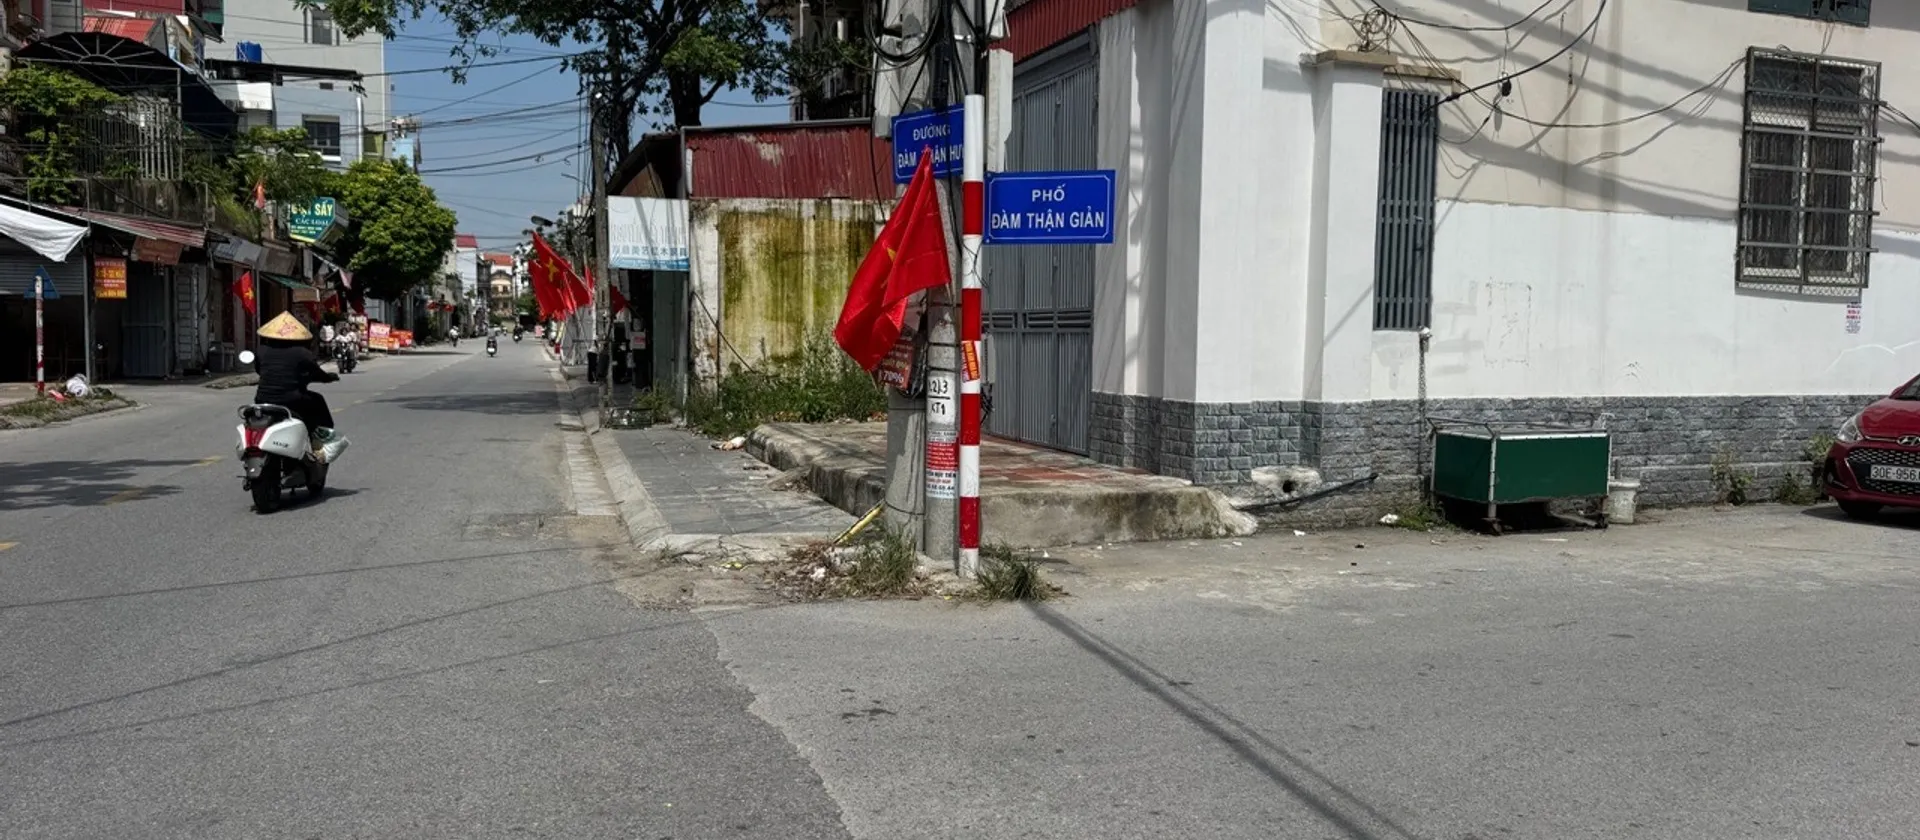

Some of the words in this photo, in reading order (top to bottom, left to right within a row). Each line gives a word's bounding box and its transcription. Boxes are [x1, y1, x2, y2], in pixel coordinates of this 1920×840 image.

[913, 123, 951, 141] ĐƯỜNG
[898, 148, 917, 169] ĐÀM
[921, 144, 947, 167] ẬN
[1031, 183, 1066, 202] PHỐ
[991, 208, 1021, 229] ĐÀM
[1026, 208, 1065, 232] THẬN
[1069, 205, 1105, 228] GIẢN
[1871, 465, 1920, 482] 30E-956.
